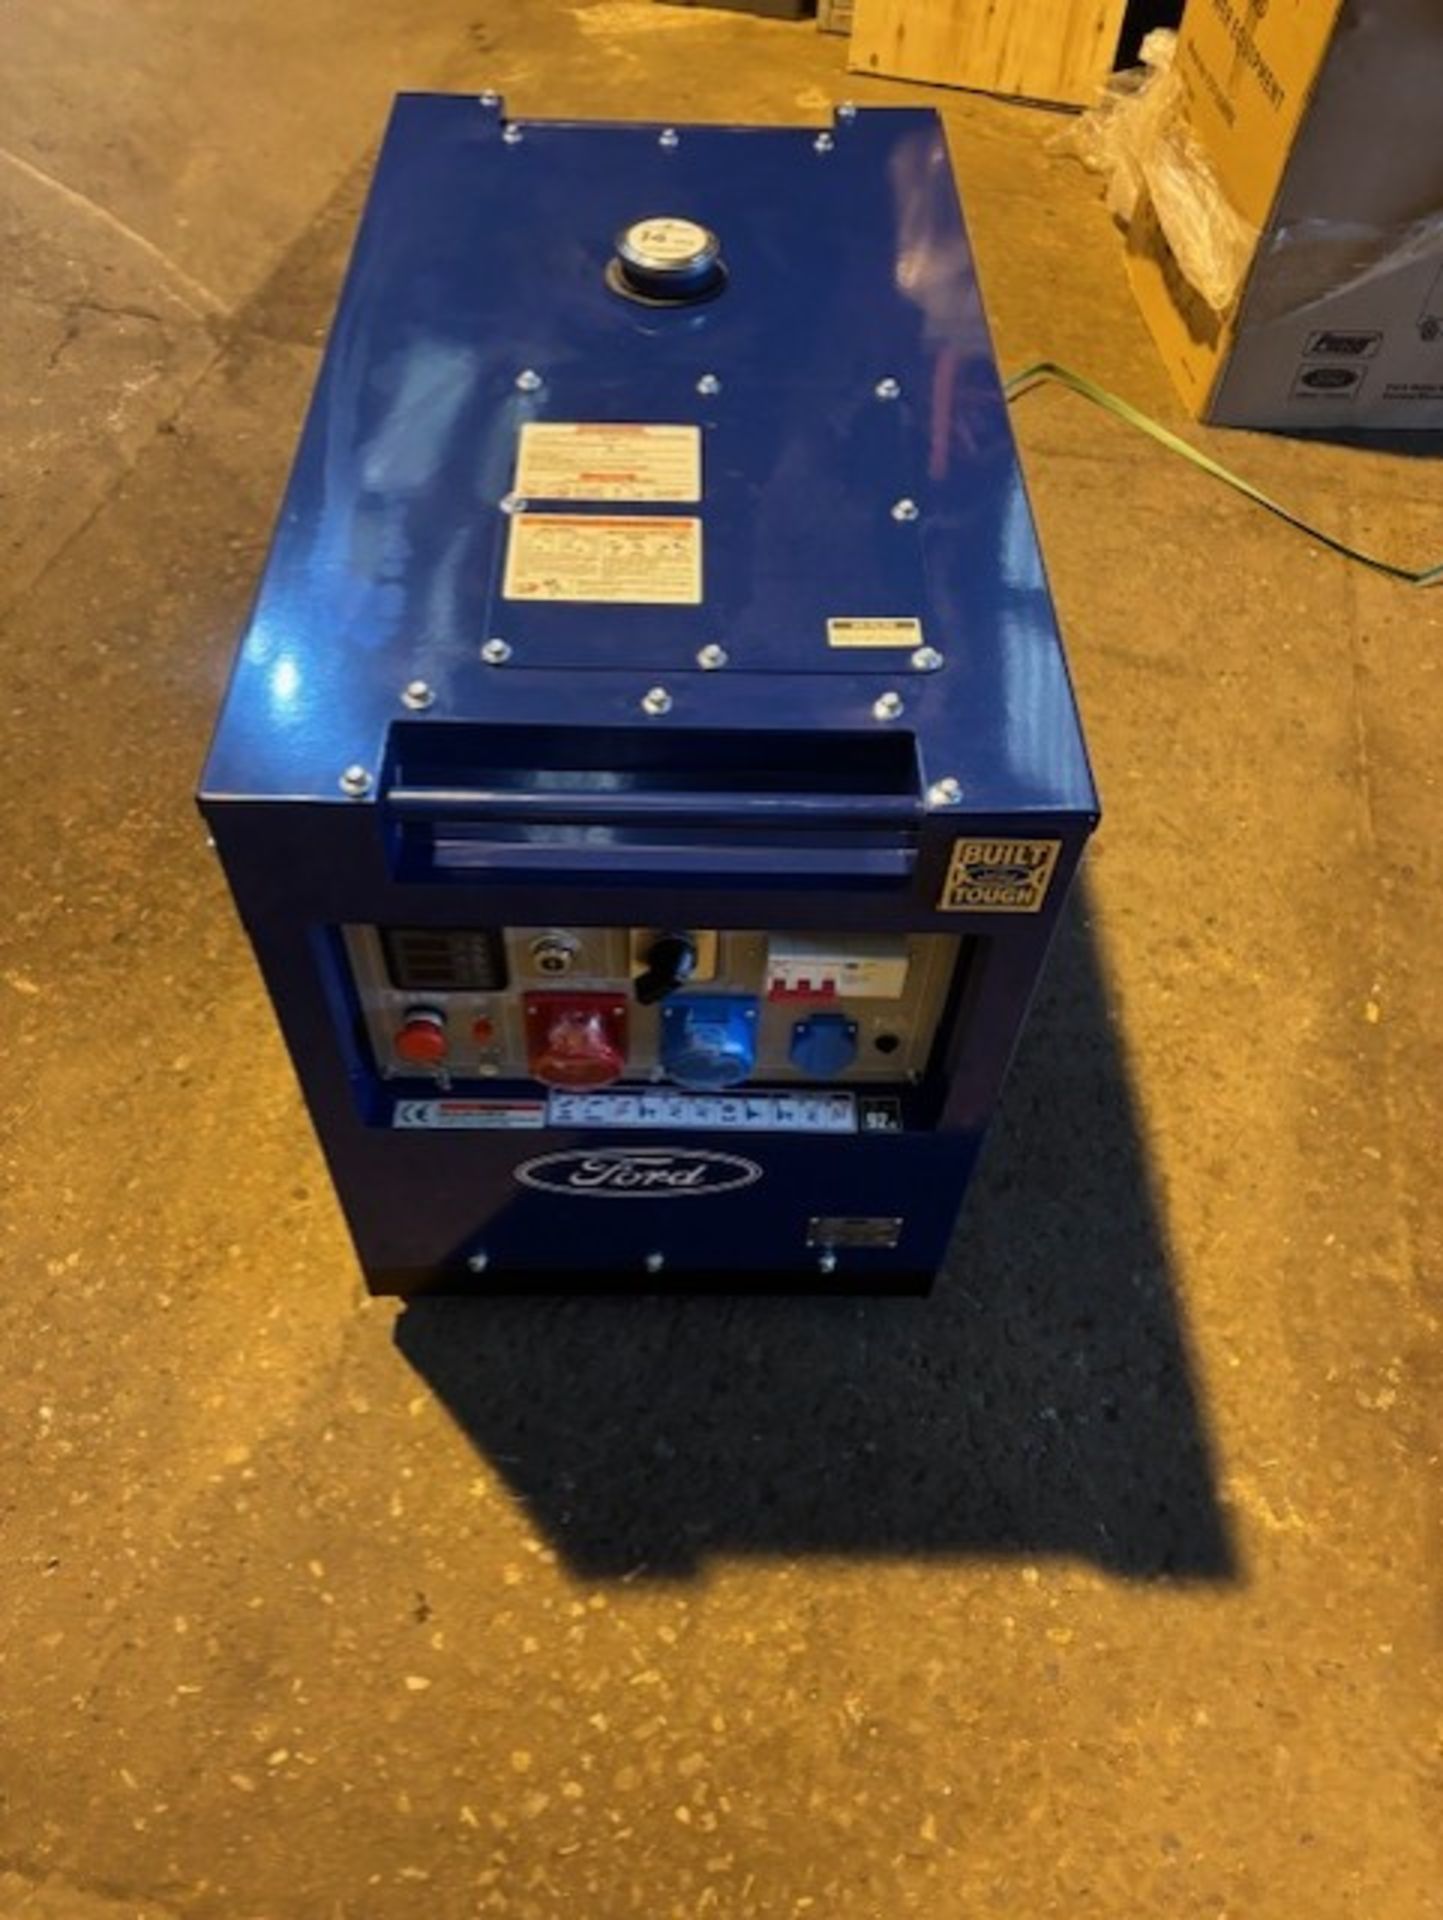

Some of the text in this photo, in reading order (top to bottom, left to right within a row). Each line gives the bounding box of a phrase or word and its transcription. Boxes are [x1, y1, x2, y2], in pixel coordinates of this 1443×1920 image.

[1229, 17, 1285, 111] EQUIPMENT
[962, 845, 1048, 866] BUILT
[953, 887, 1034, 904] TOUGH
[569, 1157, 709, 1187] Ford
